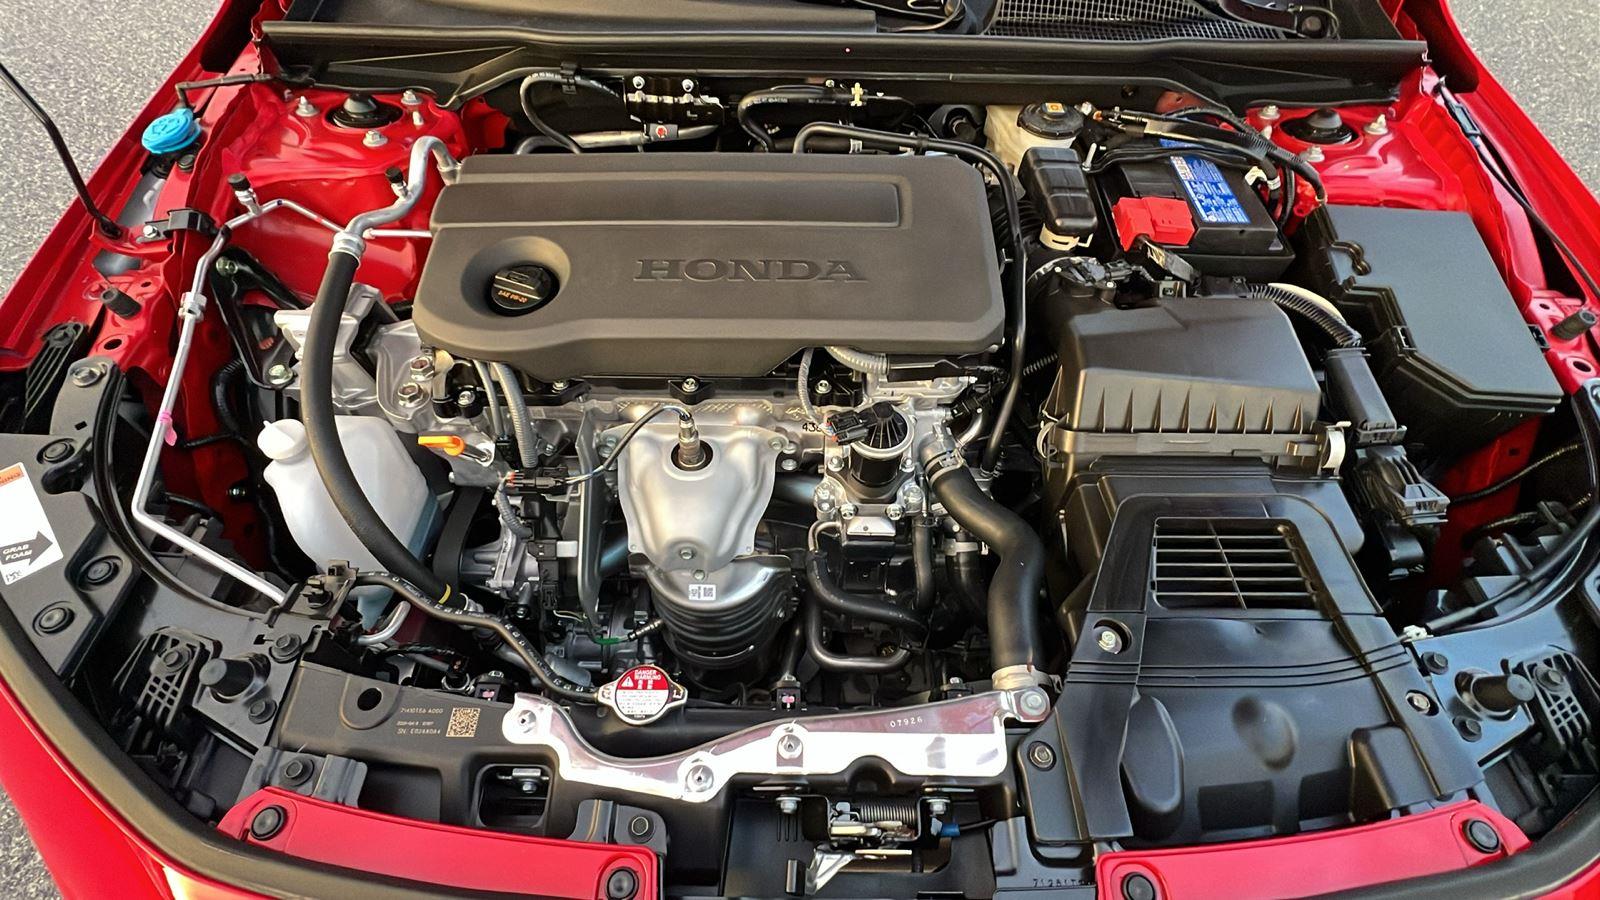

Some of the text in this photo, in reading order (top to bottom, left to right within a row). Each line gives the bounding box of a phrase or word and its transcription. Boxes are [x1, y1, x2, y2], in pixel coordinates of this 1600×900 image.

[633, 258, 868, 283] HONDA
[2, 544, 29, 555] GRAB
[5, 550, 33, 561] FOAM
[890, 715, 923, 728] 07926
